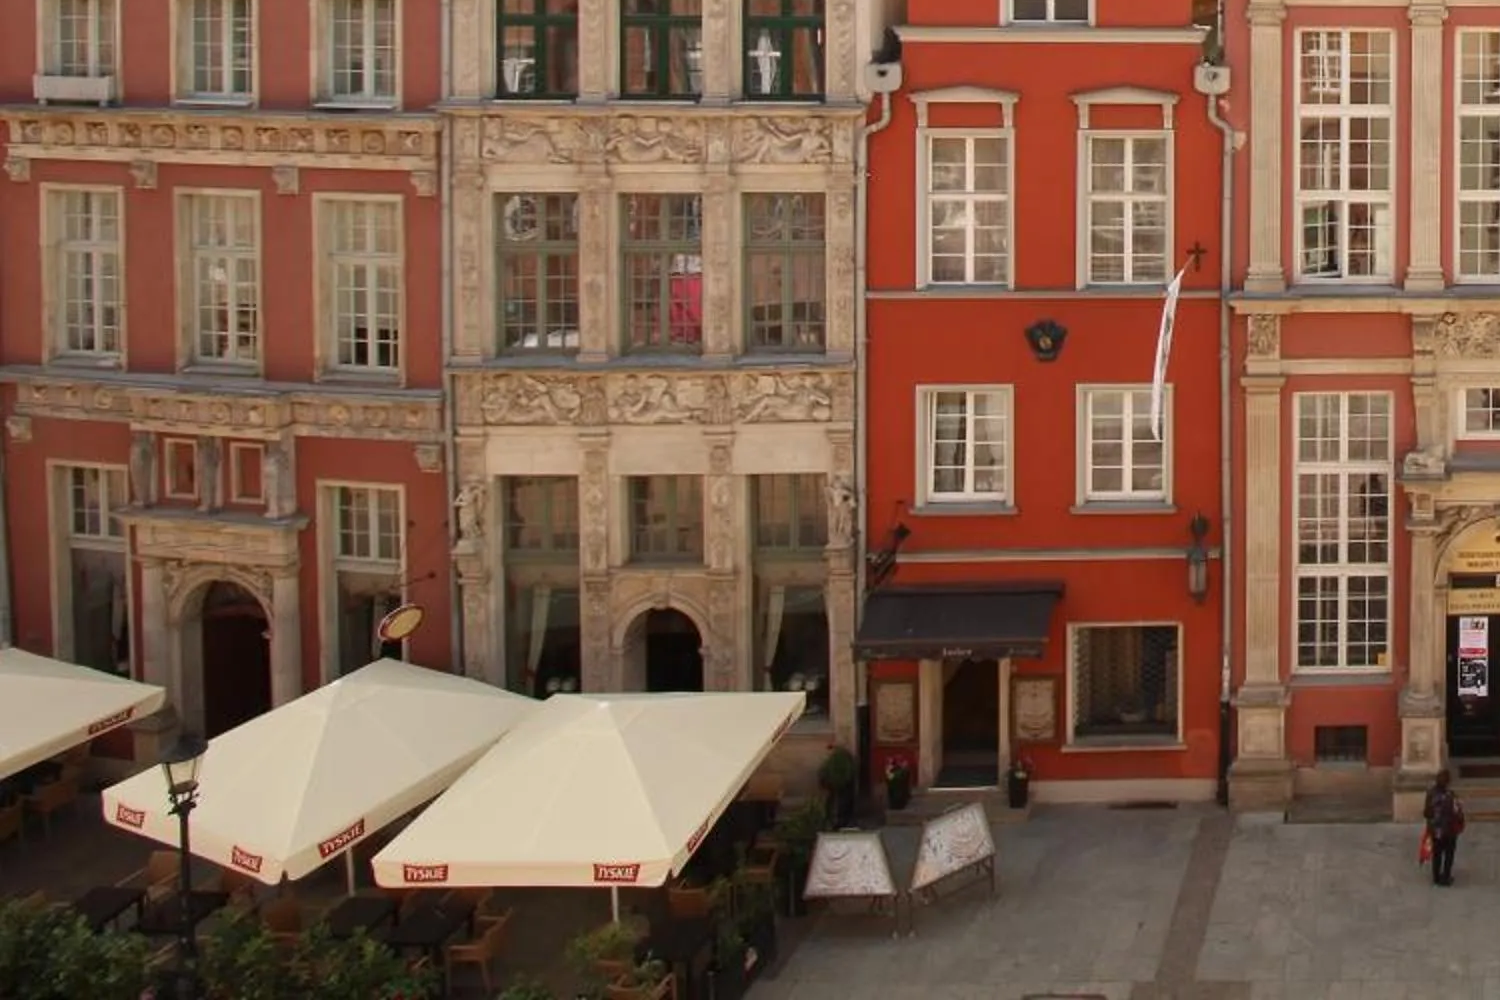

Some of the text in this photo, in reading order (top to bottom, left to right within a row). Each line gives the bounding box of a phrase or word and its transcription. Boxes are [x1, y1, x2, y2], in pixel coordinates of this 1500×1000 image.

[322, 822, 362, 855] TYSKIE
[405, 866, 446, 881] TYSKIE
[598, 866, 636, 880] TYSKIE
